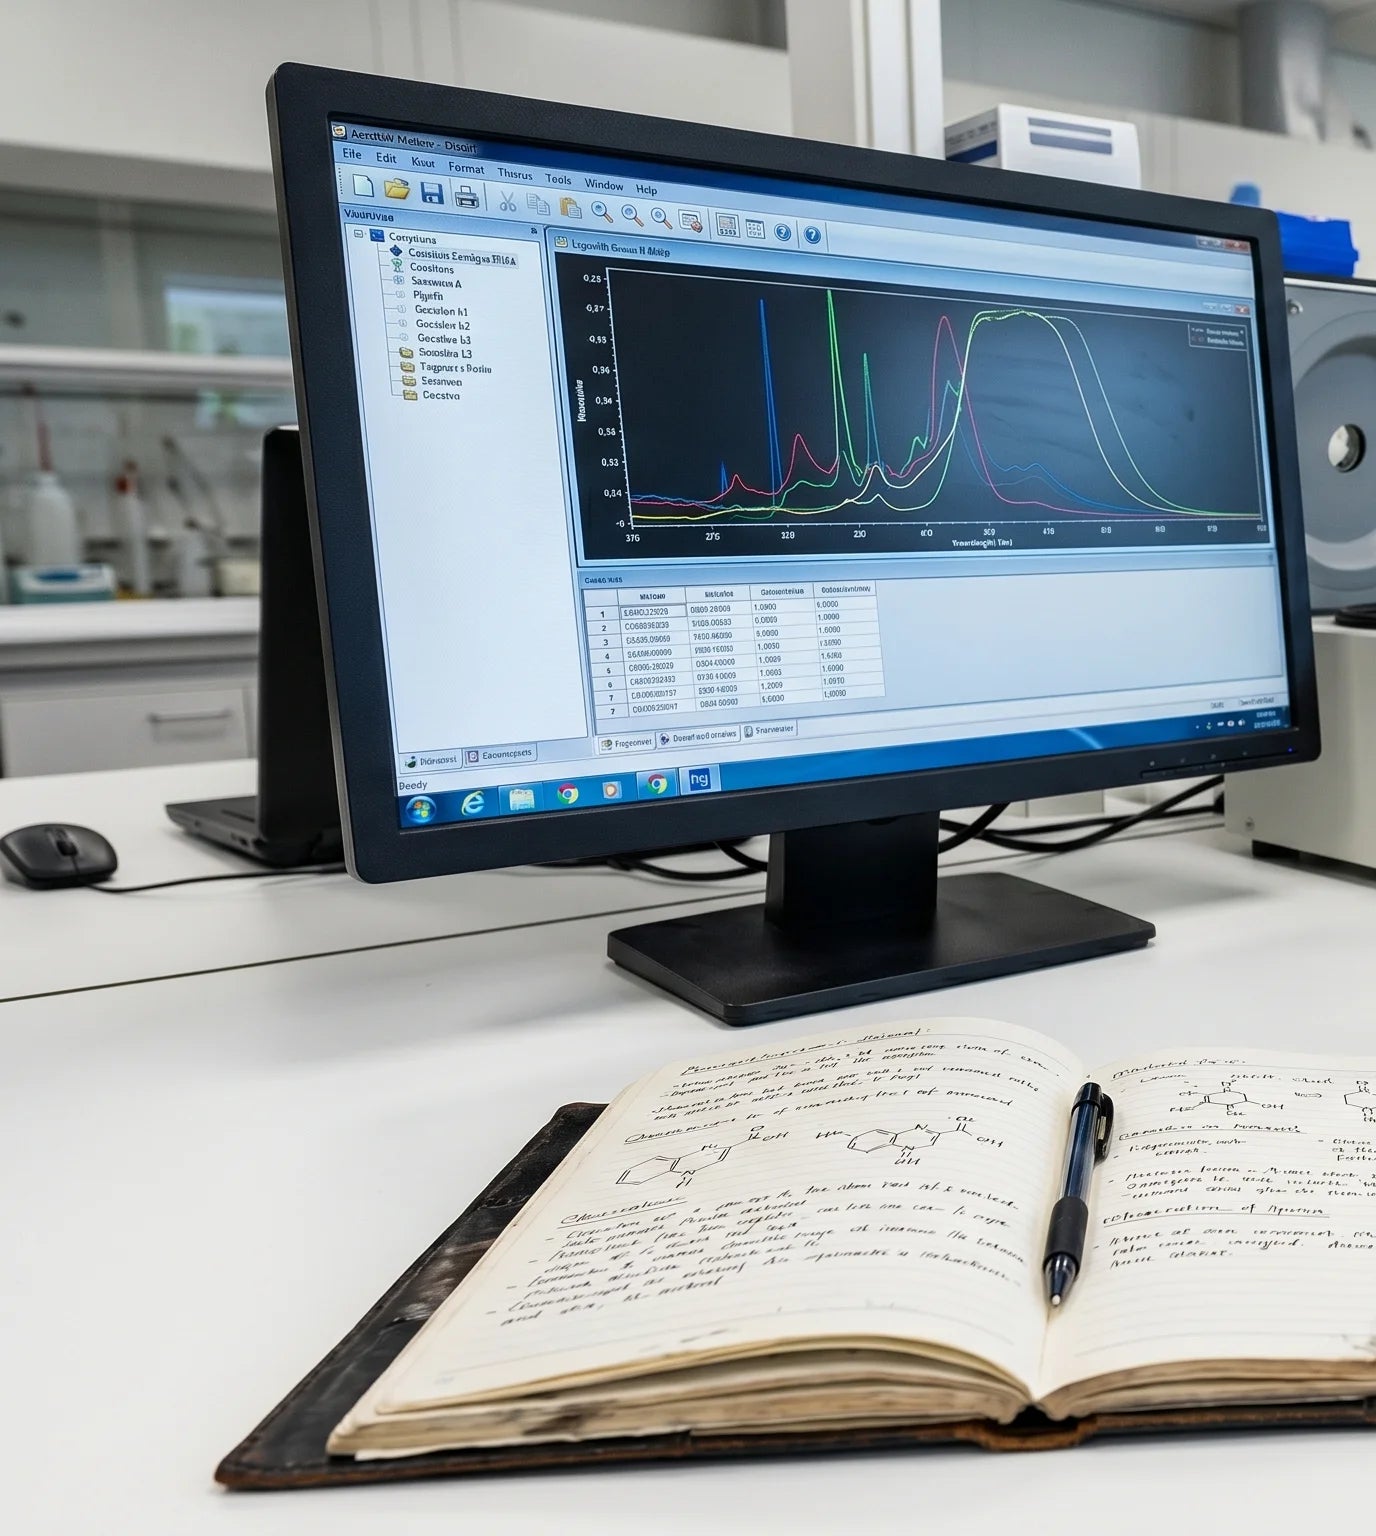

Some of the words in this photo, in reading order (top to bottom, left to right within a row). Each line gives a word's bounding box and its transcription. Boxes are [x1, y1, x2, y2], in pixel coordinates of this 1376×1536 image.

[376, 152, 397, 165] Edit
[448, 161, 485, 176] Format
[585, 178, 625, 192] Window
